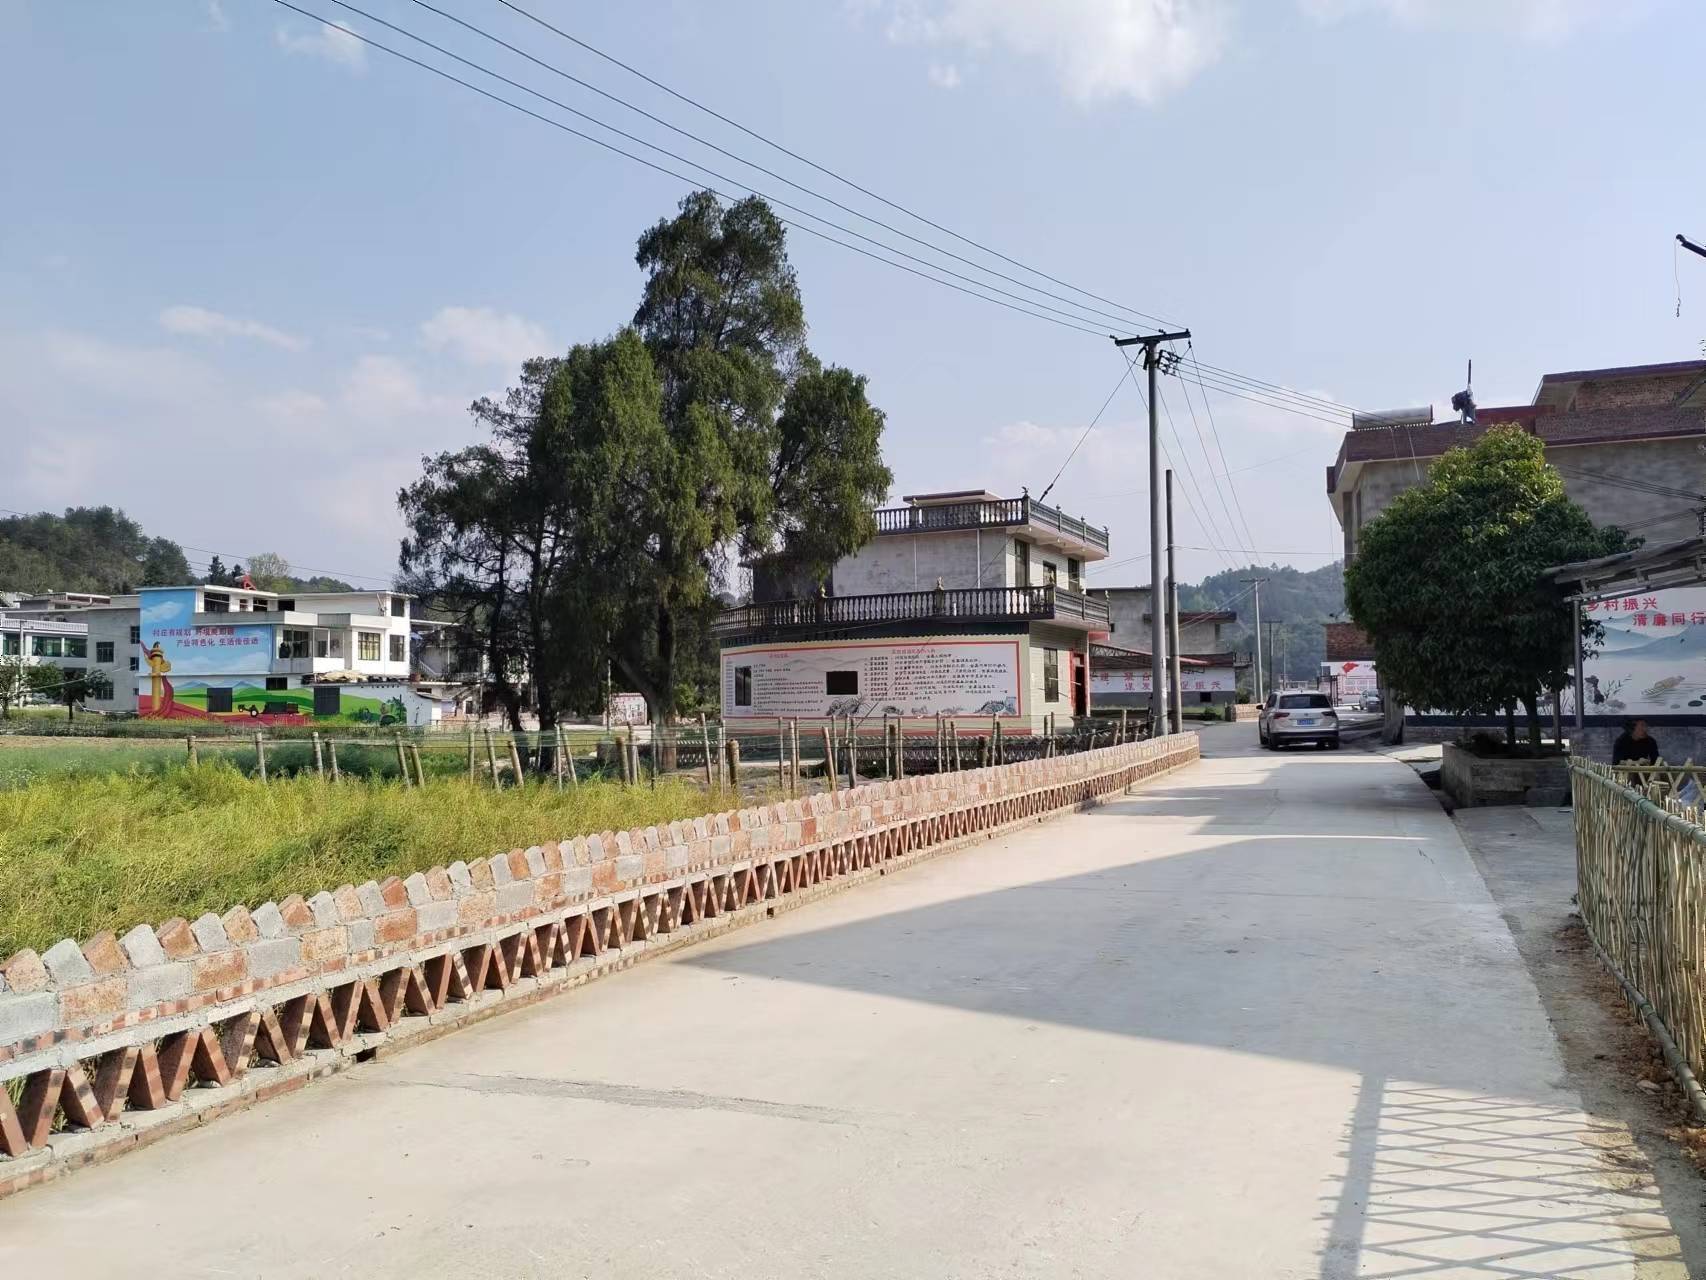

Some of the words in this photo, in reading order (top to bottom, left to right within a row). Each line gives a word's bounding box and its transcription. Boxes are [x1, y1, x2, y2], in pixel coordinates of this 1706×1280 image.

[1587, 597, 1658, 611] 乡村振兴
[1633, 612, 1706, 626] 清廉同行
